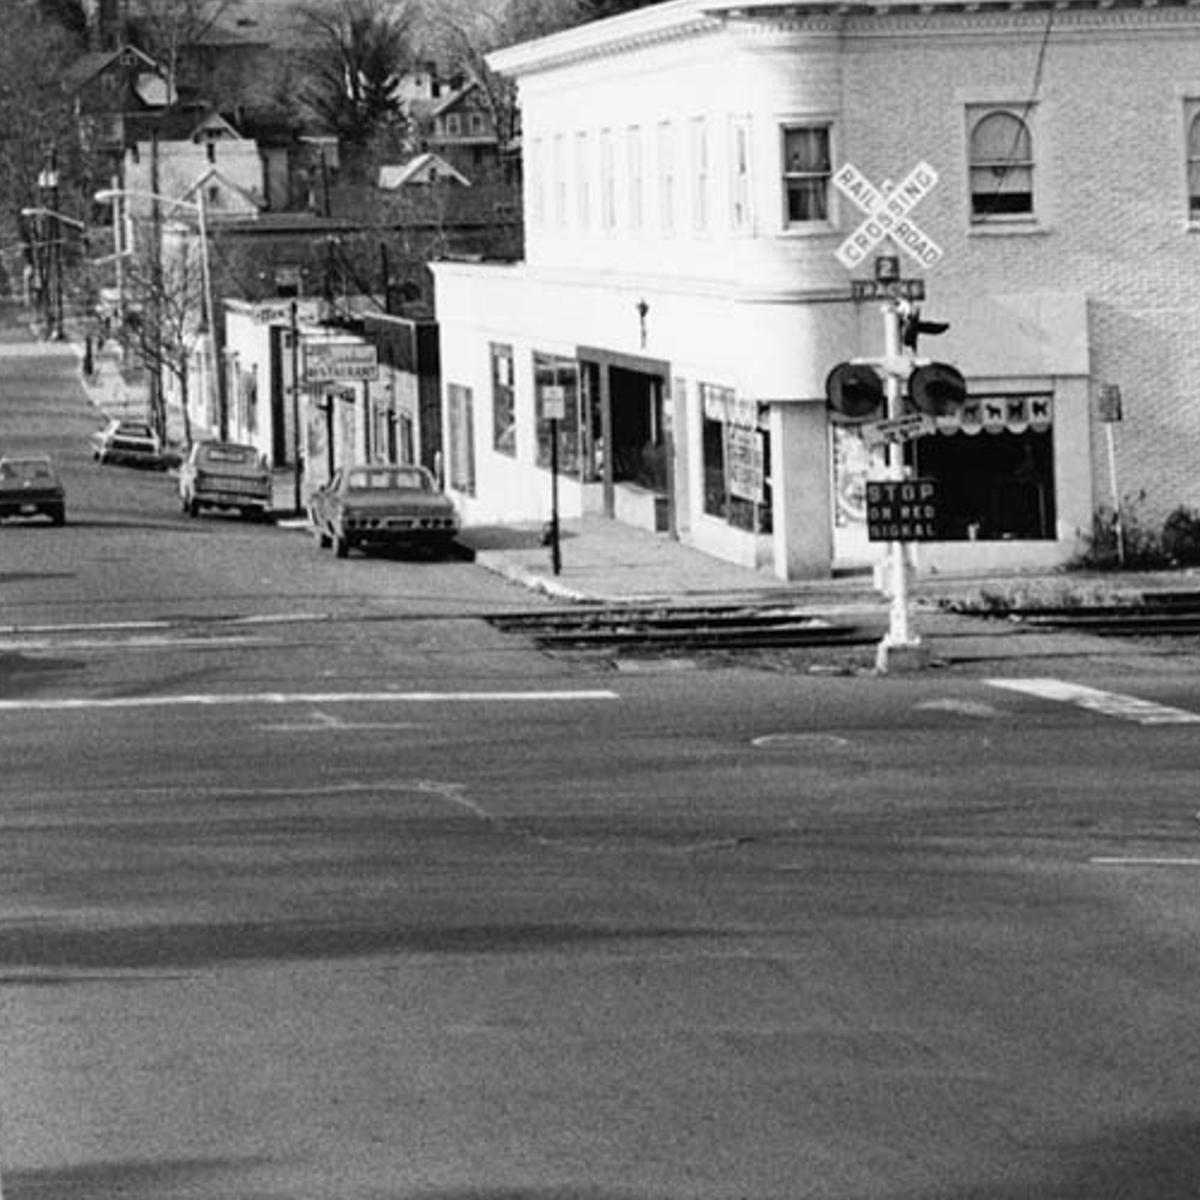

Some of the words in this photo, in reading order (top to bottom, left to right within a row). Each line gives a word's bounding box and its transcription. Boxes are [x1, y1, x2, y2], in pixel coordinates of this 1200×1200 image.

[844, 169, 931, 257] CROSSING
[879, 258, 893, 276] 2
[868, 484, 934, 502] STOP
[870, 506, 892, 520] ON
[900, 505, 935, 519] RED
[870, 523, 933, 537] SIGNAL
